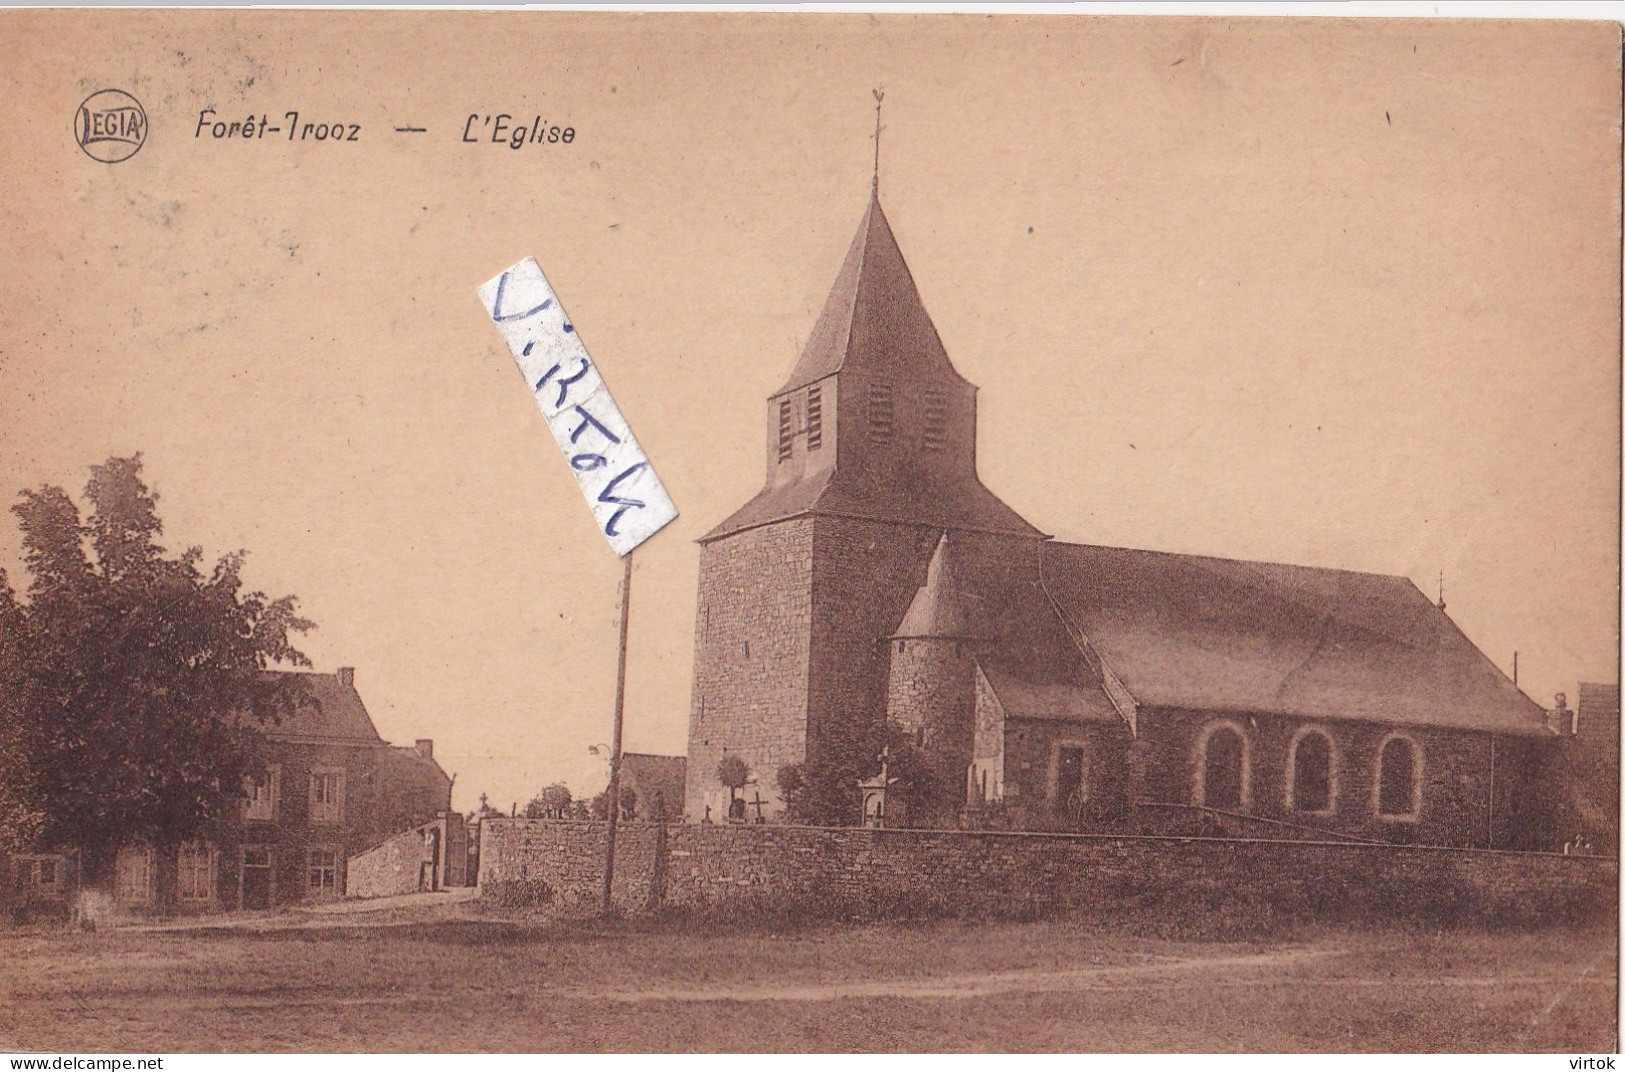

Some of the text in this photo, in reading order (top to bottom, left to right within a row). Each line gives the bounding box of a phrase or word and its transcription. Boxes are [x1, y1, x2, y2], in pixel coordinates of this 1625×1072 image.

[81, 106, 143, 146] LEGIA
[195, 109, 361, 142] Forêt-Trooz
[462, 113, 576, 150] L'Eglise
